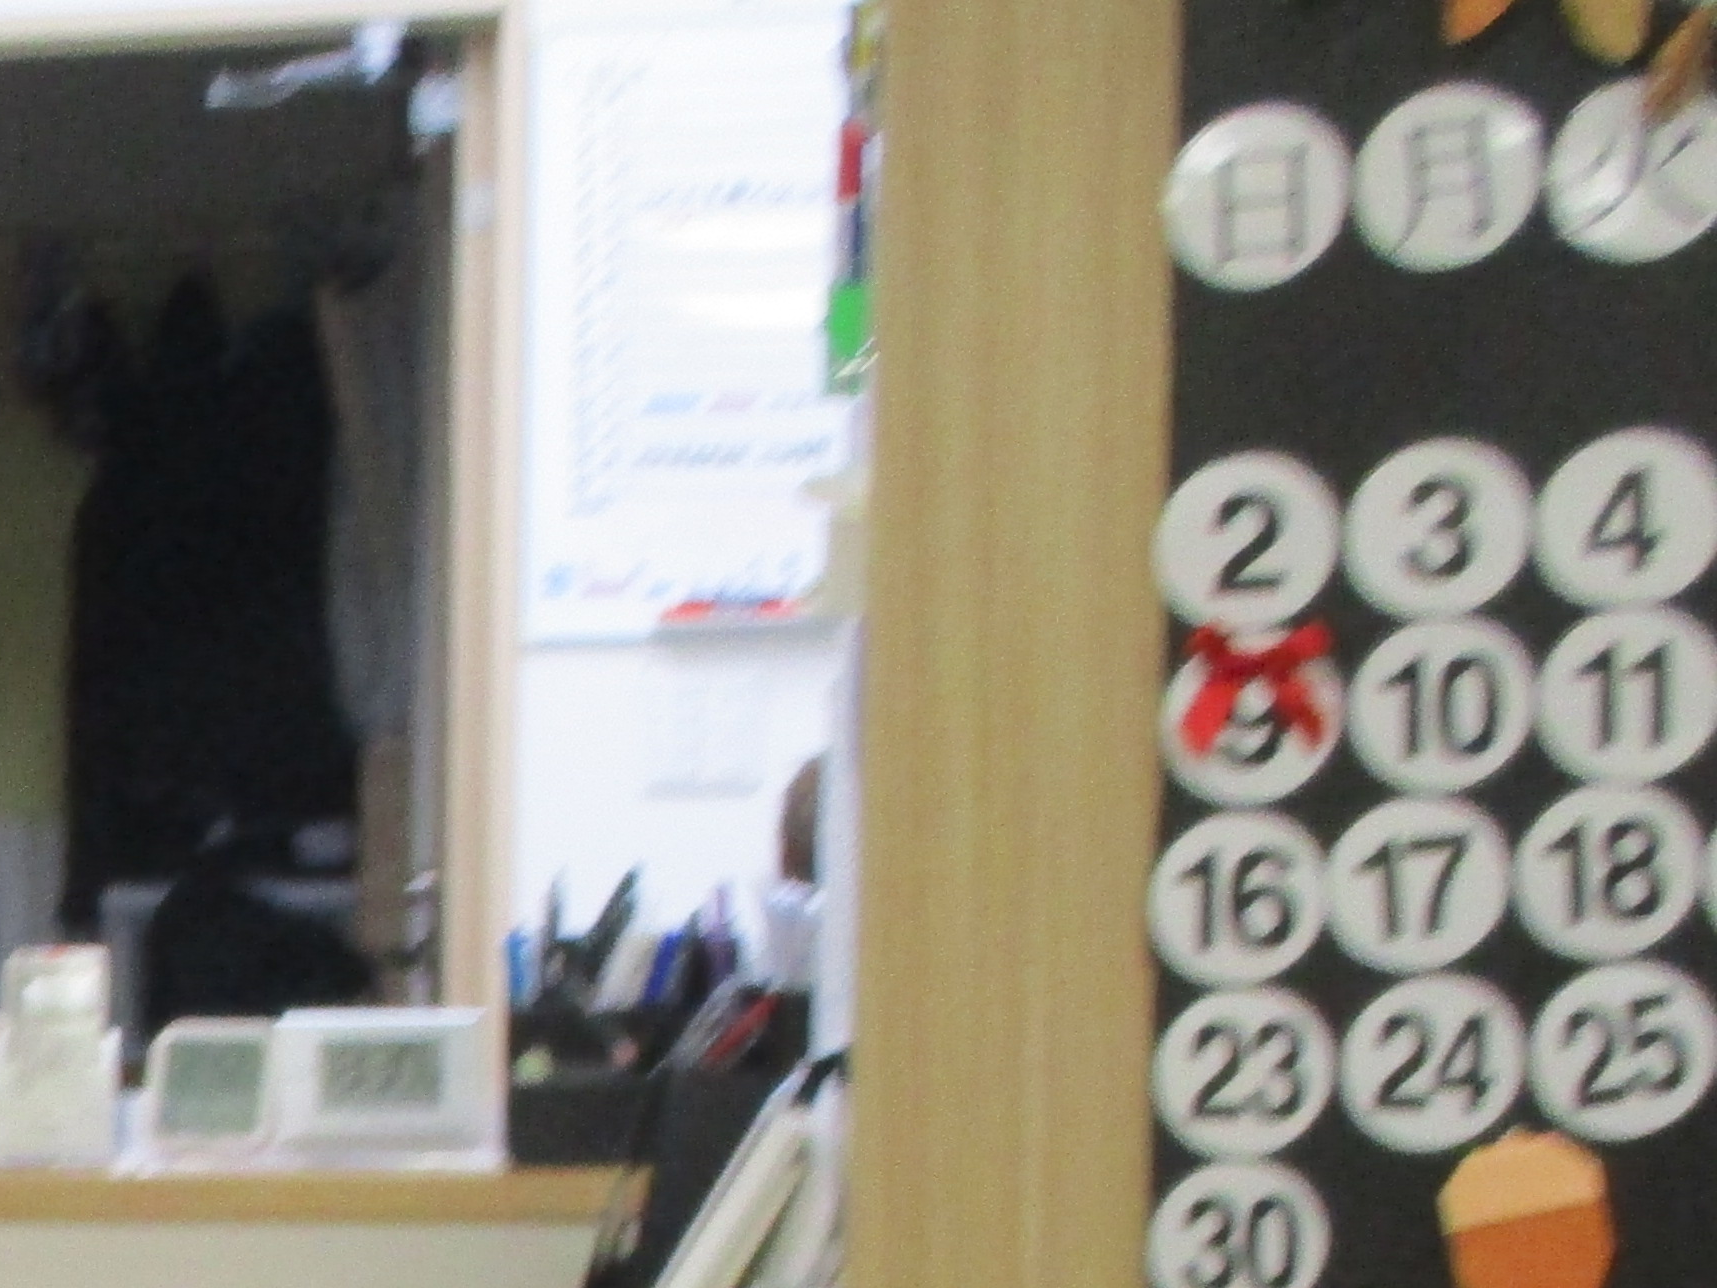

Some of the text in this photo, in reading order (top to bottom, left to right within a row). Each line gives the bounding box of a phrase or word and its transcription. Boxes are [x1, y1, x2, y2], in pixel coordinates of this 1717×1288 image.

[1210, 140, 1310, 262] 日
[1392, 112, 1495, 252] 月
[1210, 467, 1660, 596] 2 3 4
[1385, 656, 1501, 762] 10
[1575, 640, 1668, 752] 11
[1181, 816, 1661, 954] 16 17 18
[1190, 994, 1687, 1117] 23 24 25
